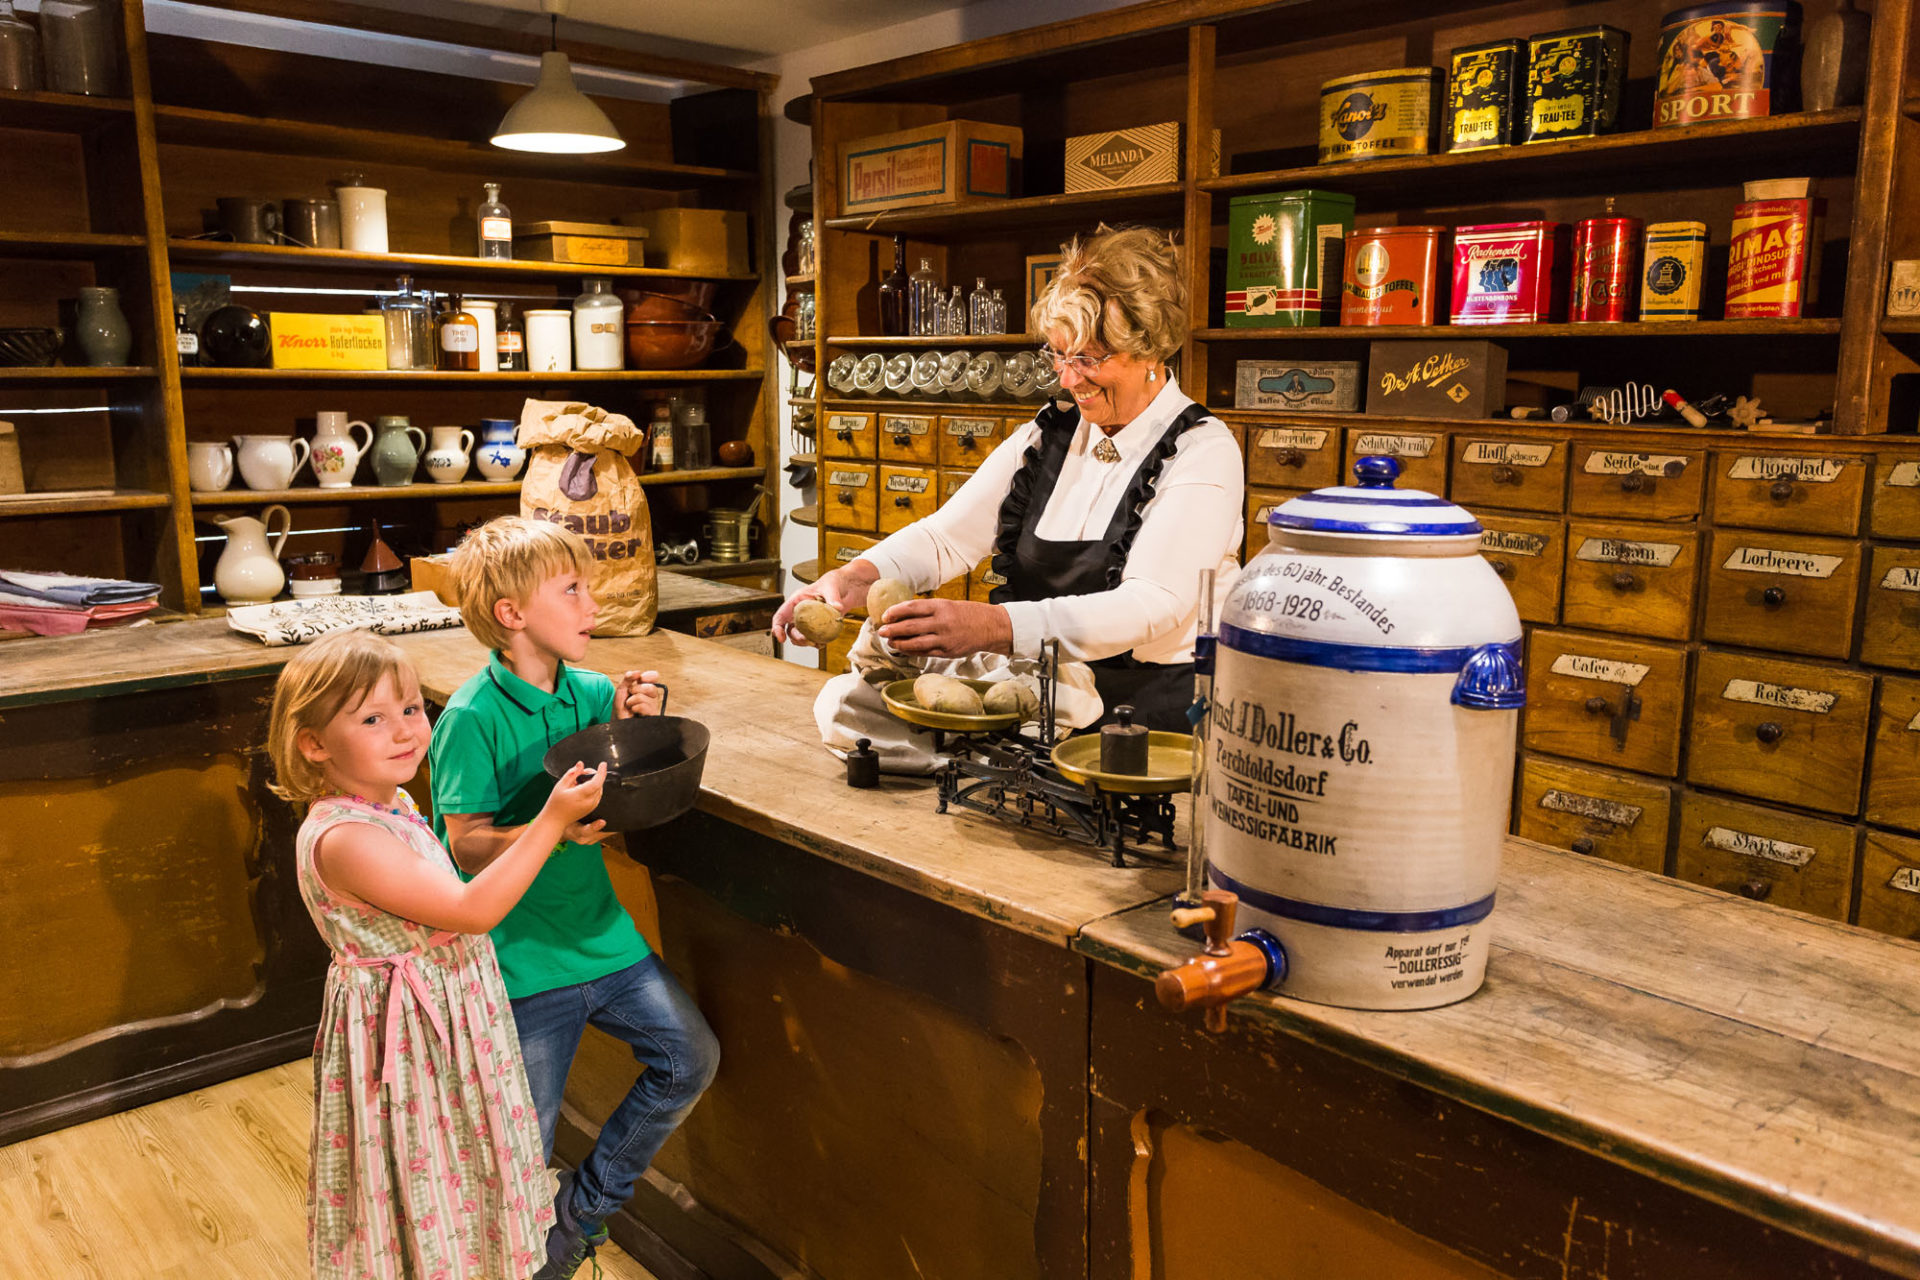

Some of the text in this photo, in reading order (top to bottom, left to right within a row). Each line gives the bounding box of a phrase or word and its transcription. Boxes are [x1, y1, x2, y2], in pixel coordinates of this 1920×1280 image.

[1660, 93, 1755, 122] SPORT
[1090, 148, 1145, 167] MELANDA
[854, 155, 896, 198] Persil
[1461, 242, 1527, 264] Rachengold
[1747, 245, 1802, 267] RINDSUPPE
[1385, 279, 1414, 294] TOFFEE
[278, 334, 328, 348] Knorr
[1422, 353, 1470, 380] Oetker
[1603, 454, 1641, 470] Seide
[1741, 548, 1821, 573] Lorbeere.
[1283, 562, 1302, 578] 60
[1296, 565, 1329, 588] jähr.
[1327, 575, 1396, 635] Bestandes
[1250, 703, 1321, 758] Doller
[1321, 735, 1335, 760] &
[1338, 719, 1374, 766] Co.
[1216, 738, 1329, 797] Perchtoldsdorf
[1211, 798, 1338, 856] WEINESSIGFABRIK
[1385, 946, 1423, 961] Apparat
[1425, 942, 1443, 957] darf
[1398, 952, 1462, 974] DOLLERESSIG
[1391, 969, 1464, 990] verwendet werden
